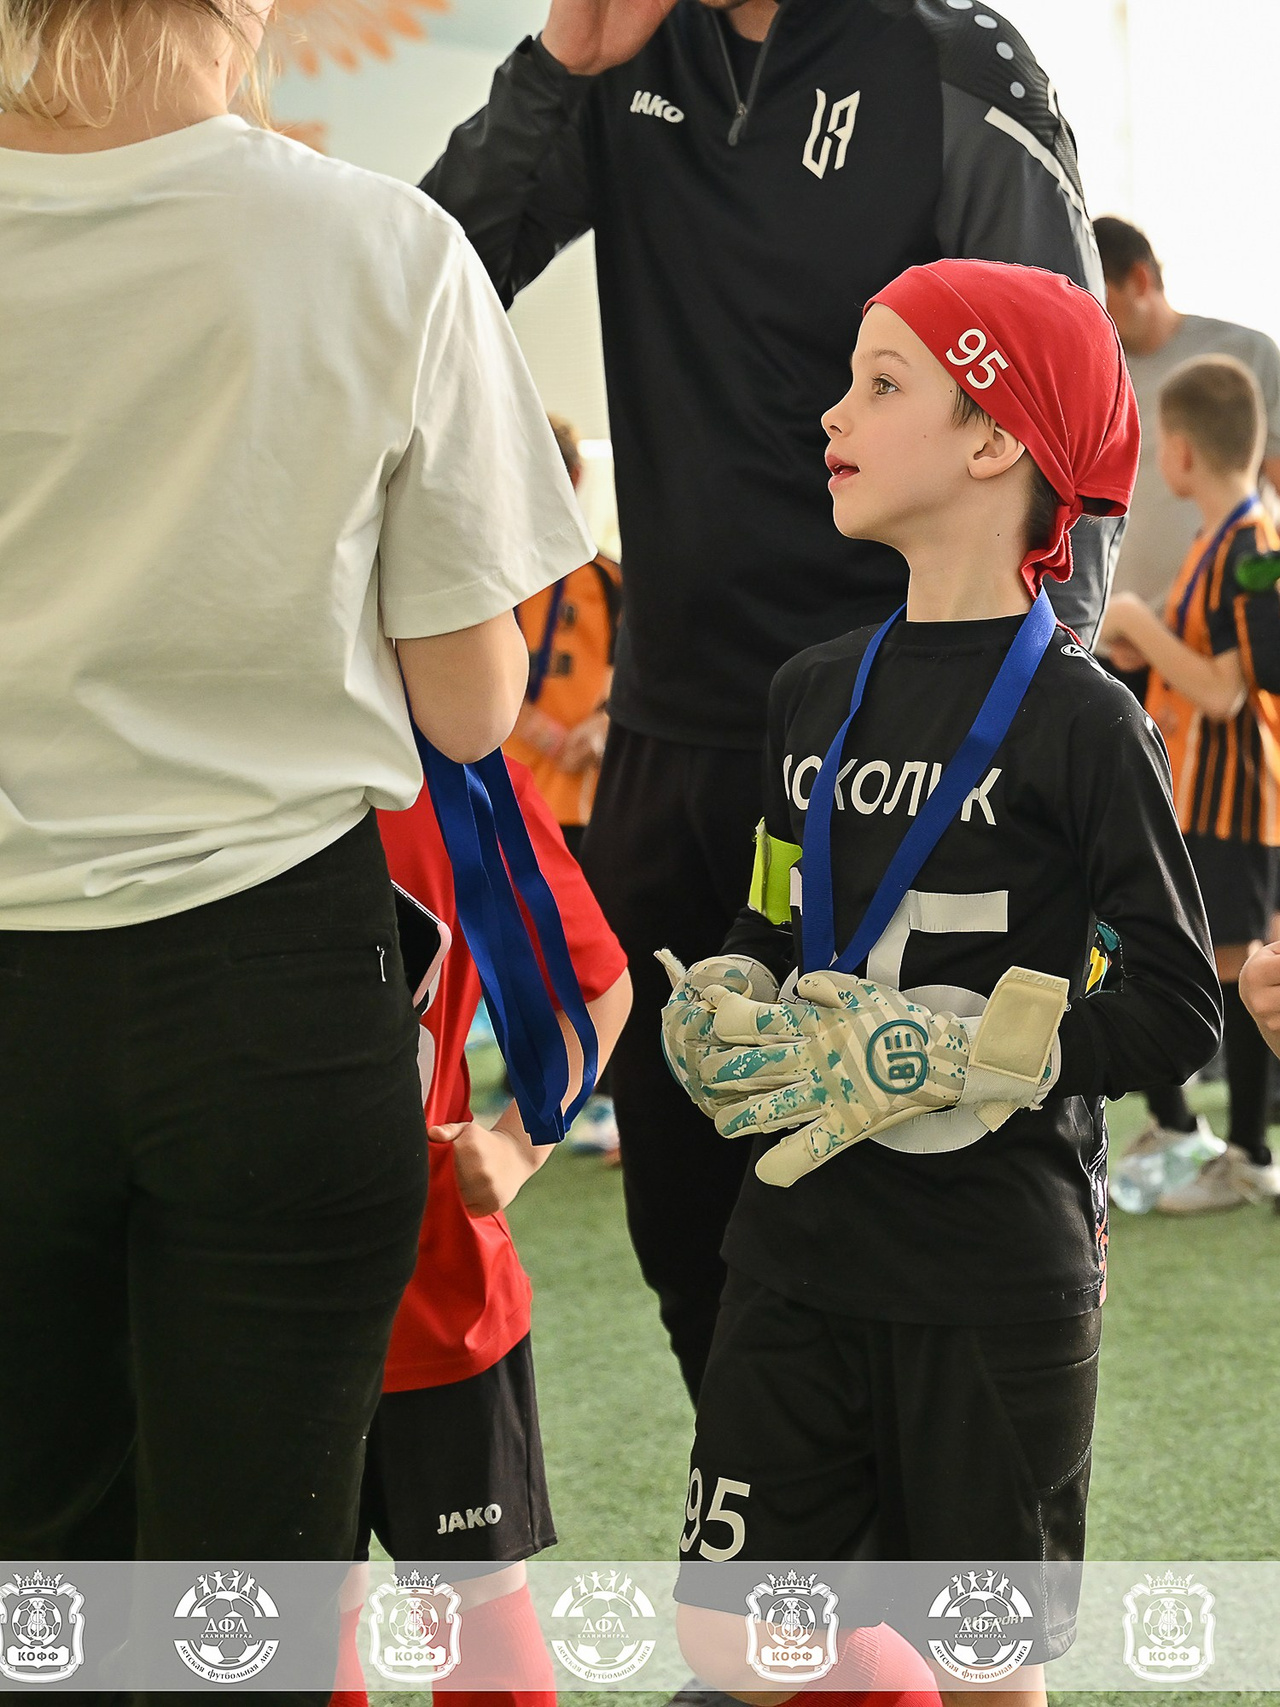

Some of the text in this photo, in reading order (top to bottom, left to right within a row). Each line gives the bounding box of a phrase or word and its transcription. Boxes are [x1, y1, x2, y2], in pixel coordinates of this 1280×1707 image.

[944, 327, 1010, 390] 95
[436, 1502, 503, 1535] JAKO
[679, 1467, 751, 1563] 95
